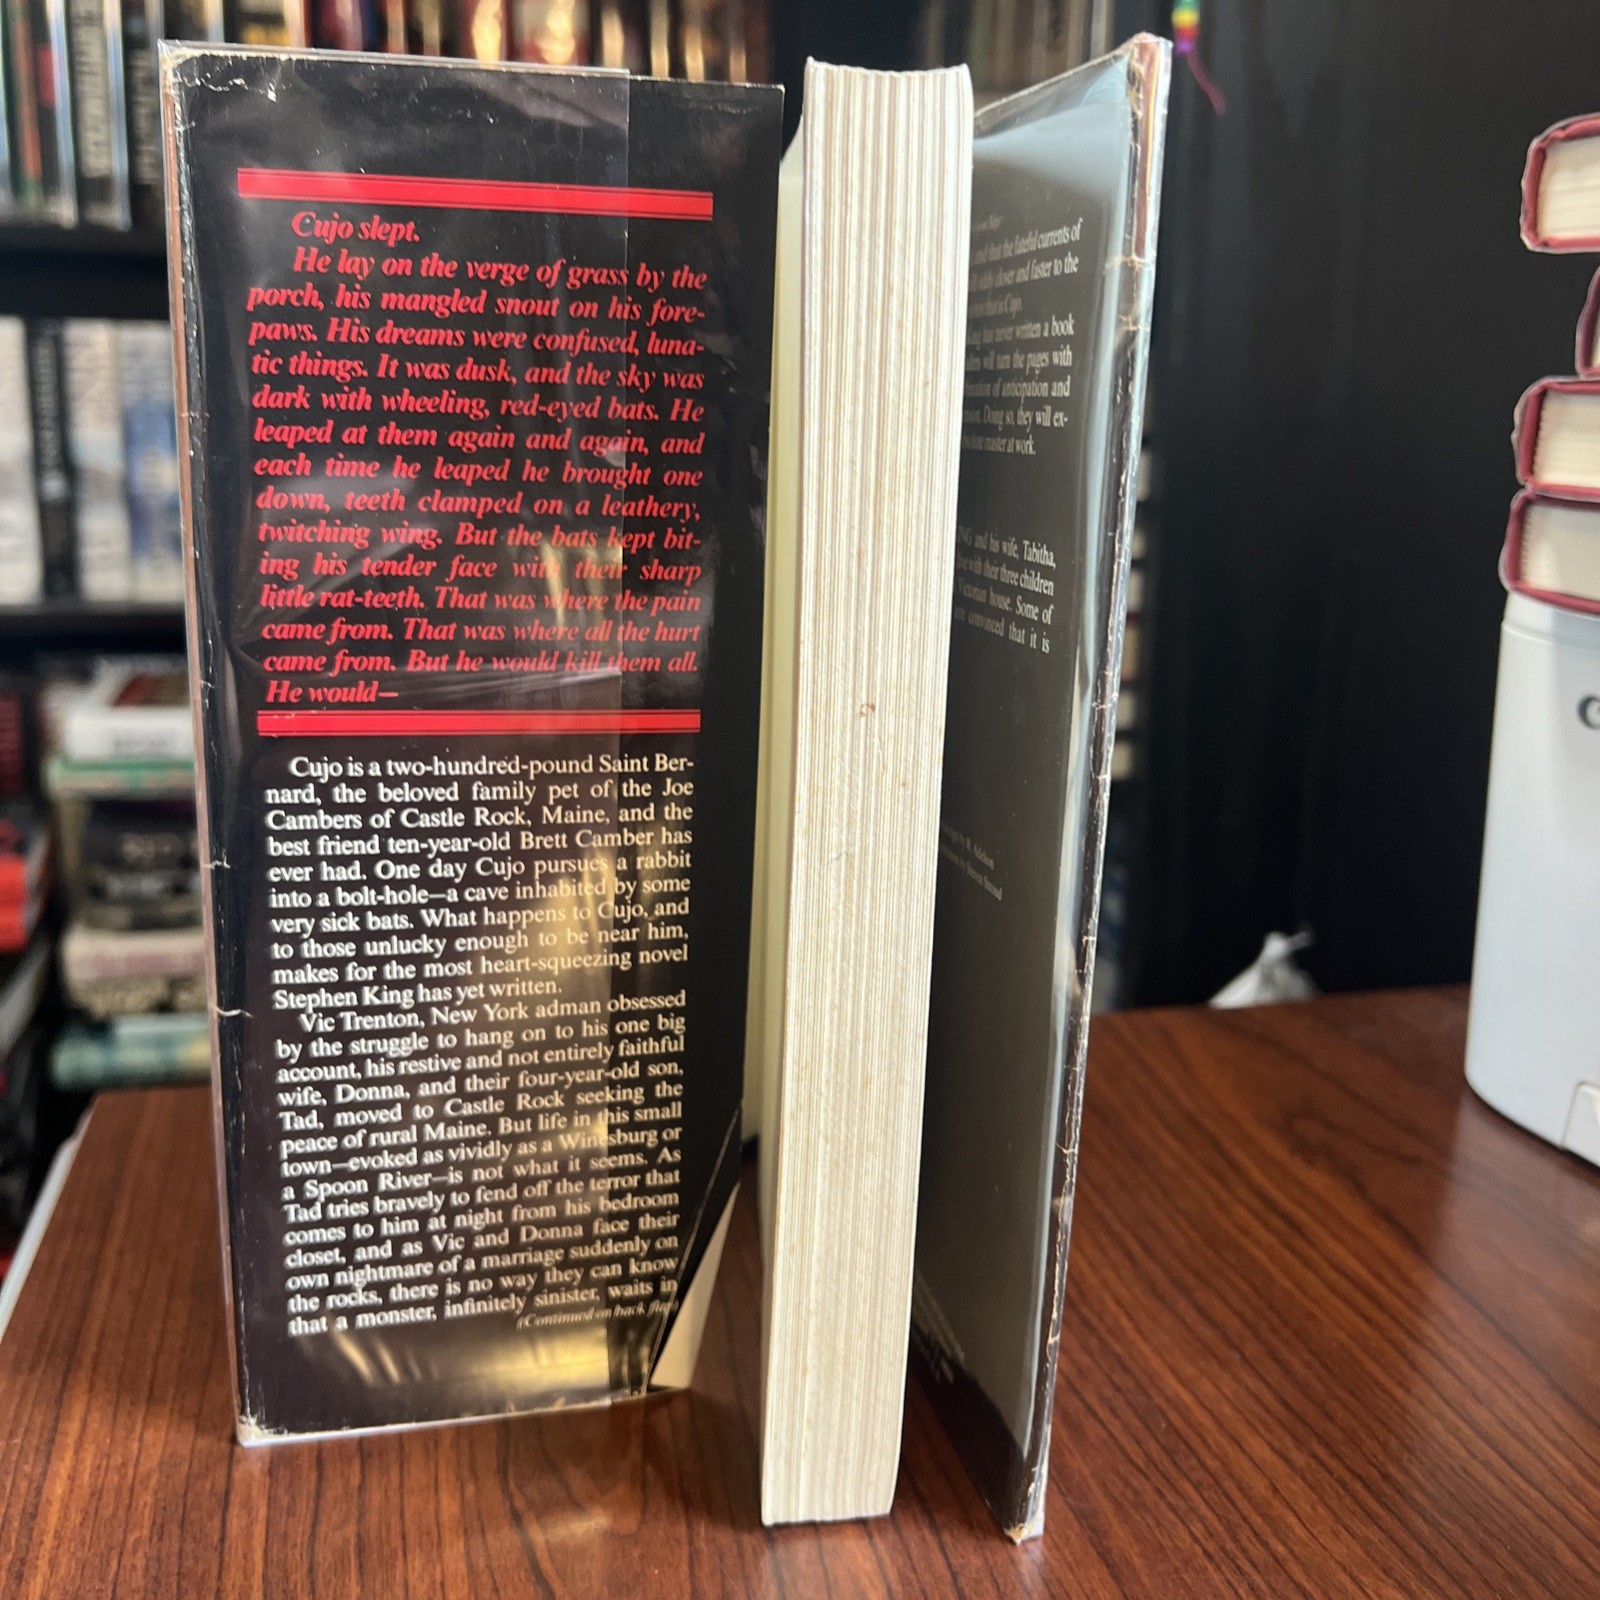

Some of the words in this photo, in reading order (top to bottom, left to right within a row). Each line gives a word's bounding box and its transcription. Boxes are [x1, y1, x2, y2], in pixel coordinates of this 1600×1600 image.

[292, 213, 355, 245] Cujo
[359, 217, 420, 248] slept.
[1037, 225, 1070, 249] currents
[1070, 216, 1083, 241] of
[294, 248, 332, 273] He
[338, 249, 375, 282] lay
[381, 260, 414, 277] on
[420, 255, 458, 279] the
[466, 263, 530, 289] verge
[534, 258, 565, 291] of
[567, 267, 630, 291] grass
[636, 264, 665, 295] by
[672, 266, 709, 289] the
[1053, 258, 1063, 276] to
[1064, 251, 1079, 275] the
[248, 285, 327, 314] porch,
[335, 286, 372, 310] his
[380, 290, 487, 320] mangled
[495, 296, 560, 317] snout
[569, 301, 600, 318] on
[608, 296, 643, 319] his
[652, 297, 707, 328] fore-
[250, 325, 320, 349] paws.
[327, 321, 372, 345] His
[376, 322, 467, 348] dreams
[472, 332, 528, 349] were
[532, 328, 642, 359] confused,
[648, 330, 706, 355] luna-
[1015, 320, 1041, 339] written
[1043, 321, 1049, 337] a
[1051, 313, 1075, 337] book
[251, 352, 282, 375] tic
[288, 353, 370, 385] things.
[378, 356, 399, 379] It
[404, 363, 452, 380] was
[456, 358, 520, 386] dusk,
[525, 361, 570, 384] and
[576, 362, 612, 386] the
[618, 364, 658, 394] sky
[662, 371, 706, 389] was
[1026, 351, 1049, 376] pages
[1052, 344, 1072, 367] with
[252, 386, 312, 410] dark
[320, 388, 374, 412] with
[380, 390, 494, 423] wheeling,
[500, 394, 601, 425] red-eyed
[608, 396, 662, 420] bats.
[671, 398, 706, 421] He
[1001, 376, 1048, 404] anticipation
[1051, 374, 1071, 397] and
[1016, 405, 1033, 433] they
[1035, 405, 1051, 427] will
[1053, 410, 1068, 428] ex-
[1015, 434, 1036, 455] work.
[254, 454, 313, 477] each
[325, 454, 381, 478] time
[392, 456, 423, 479] he
[434, 457, 511, 488] leaped
[522, 459, 551, 482] he
[562, 460, 653, 491] brought
[663, 468, 705, 486] one
[256, 485, 334, 513] down,
[344, 488, 408, 511] teeth
[417, 489, 523, 521] clamped
[533, 498, 566, 515] on
[575, 499, 592, 516] a
[601, 493, 705, 525] leathery,
[1002, 537, 1019, 560] wife,
[1023, 540, 1056, 570] Tabitha,
[1000, 563, 1019, 587] three
[1020, 568, 1054, 597] children
[989, 587, 1013, 612] house.
[1016, 595, 1040, 621] Some
[1042, 603, 1055, 625] of
[1009, 621, 1025, 645] that
[1030, 628, 1037, 650] it
[1042, 632, 1050, 654] is
[267, 679, 304, 702] He
[308, 679, 401, 702] would—
[289, 757, 342, 782] Cujo
[347, 756, 363, 776] is
[368, 762, 381, 776] a
[387, 754, 592, 780] two-hundred-pound
[599, 753, 648, 773] Saint
[655, 753, 693, 772] Ber-
[266, 783, 321, 805] nard,
[333, 782, 366, 802] the
[378, 780, 458, 801] beloved
[472, 779, 536, 805] family
[549, 780, 578, 804] pet
[590, 778, 617, 798] of
[622, 778, 651, 797] the
[662, 777, 693, 796] Joe
[266, 809, 362, 829] Cambers
[370, 807, 394, 827] of
[400, 806, 464, 826] Castle
[475, 805, 531, 827] Rock,
[542, 804, 610, 825] Maine,
[618, 802, 654, 822] and
[664, 801, 692, 821] the
[268, 836, 310, 856] best
[318, 833, 379, 854] friend
[388, 830, 510, 857] ten-year-old
[521, 829, 567, 849] Brett
[575, 826, 654, 847] Camber
[661, 825, 692, 845] has
[268, 866, 312, 881] ever
[321, 859, 366, 879] had.
[375, 858, 420, 878] One
[429, 856, 466, 881] day
[475, 855, 524, 879] Cujo
[534, 856, 608, 877] pursues
[617, 856, 627, 870] a
[636, 848, 690, 869] rabbit
[270, 888, 311, 907] into
[317, 891, 329, 905] a
[336, 883, 458, 905] bolt-hole—a
[464, 885, 508, 900] cave
[516, 875, 606, 898] inhabited
[609, 875, 636, 900] by
[642, 878, 690, 893] some
[274, 987, 357, 1013] Stephen
[363, 984, 414, 1008] King
[418, 982, 452, 1001] has
[456, 981, 484, 1005] yet
[490, 977, 562, 997] written.
[279, 1108, 323, 1130] Tad,
[335, 1101, 402, 1125] moved
[413, 1101, 434, 1119] to
[444, 1093, 504, 1116] Castle
[517, 1088, 564, 1110] Rock
[576, 1083, 644, 1107] seeking
[655, 1079, 683, 1099] the
[289, 1314, 327, 1335] that
[334, 1316, 348, 1330] a
[356, 1304, 436, 1327] monster,
[445, 1291, 525, 1318] infinitely
[534, 1286, 600, 1308] sinister,
[608, 1277, 653, 1299] waits
[660, 1274, 678, 1294] in
